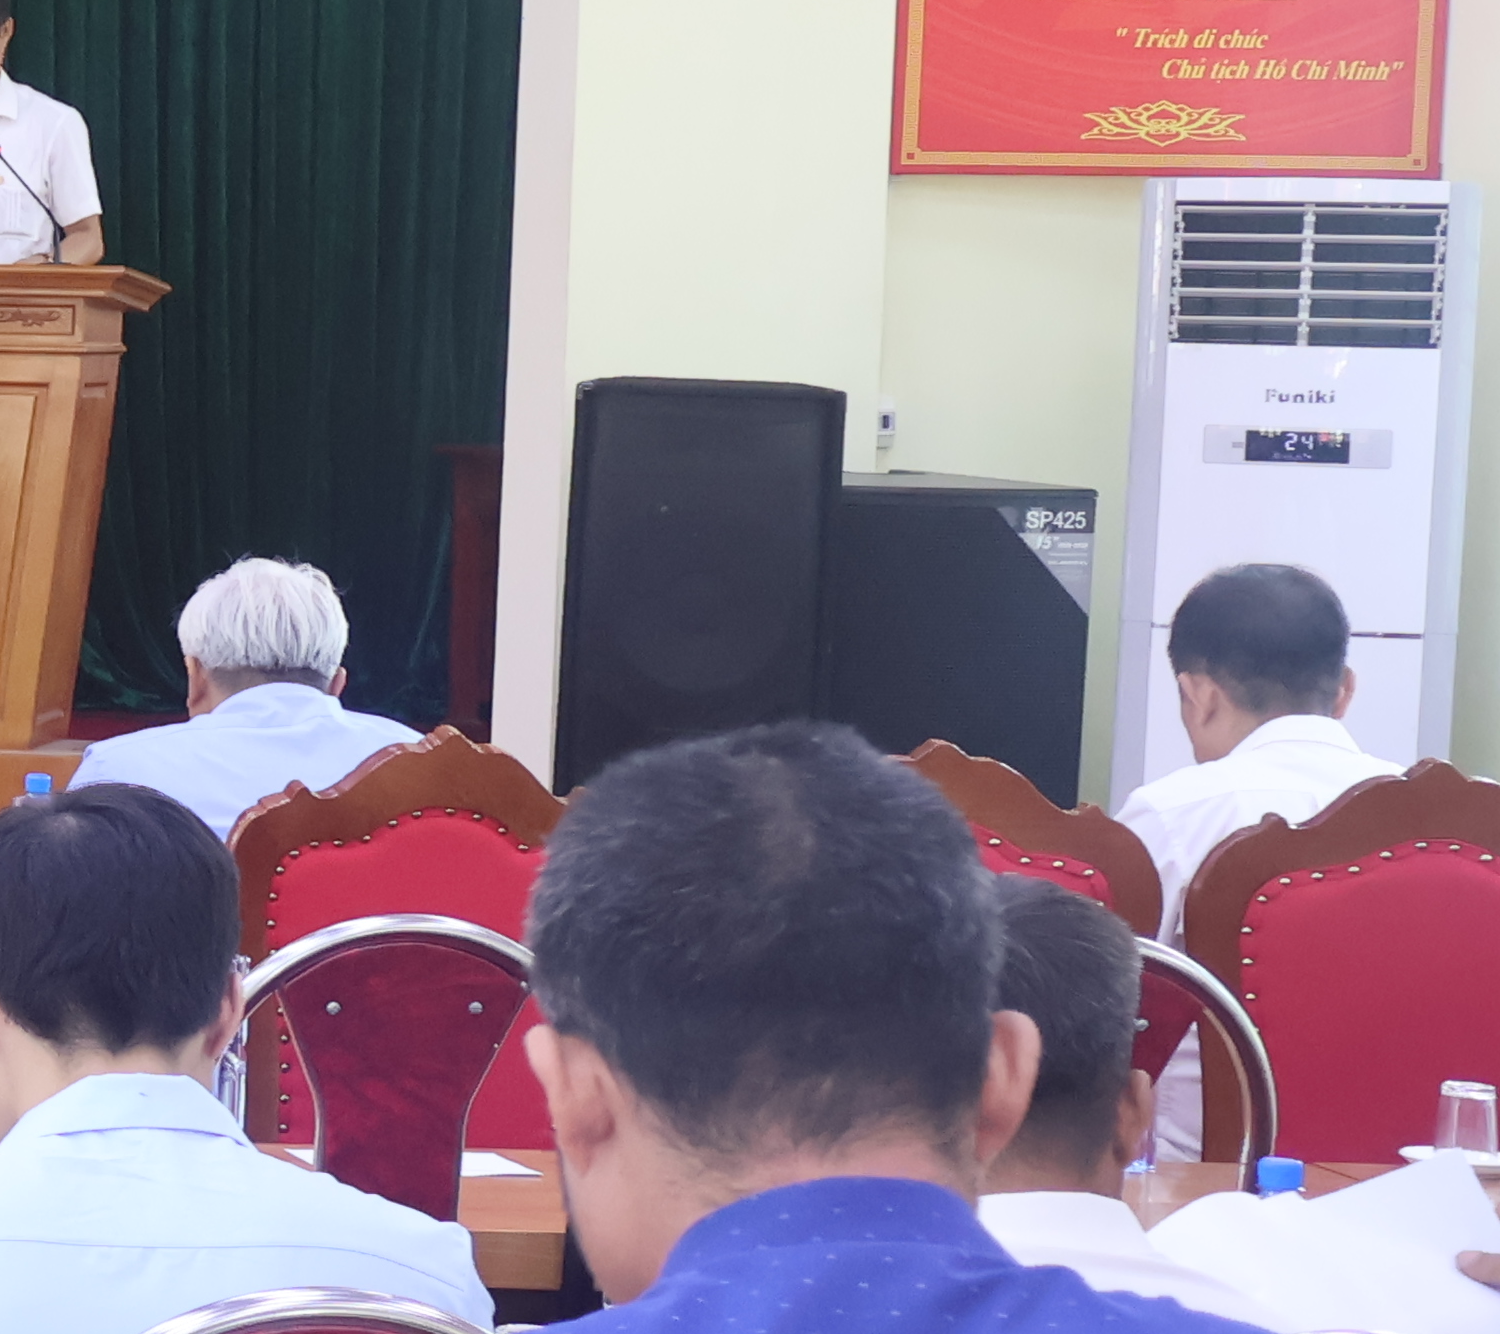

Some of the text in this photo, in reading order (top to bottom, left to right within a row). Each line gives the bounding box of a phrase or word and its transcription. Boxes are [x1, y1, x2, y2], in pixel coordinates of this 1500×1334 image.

[1264, 388, 1337, 404] Funiki
[1283, 432, 1314, 452] 24
[1025, 511, 1087, 529] SP425
